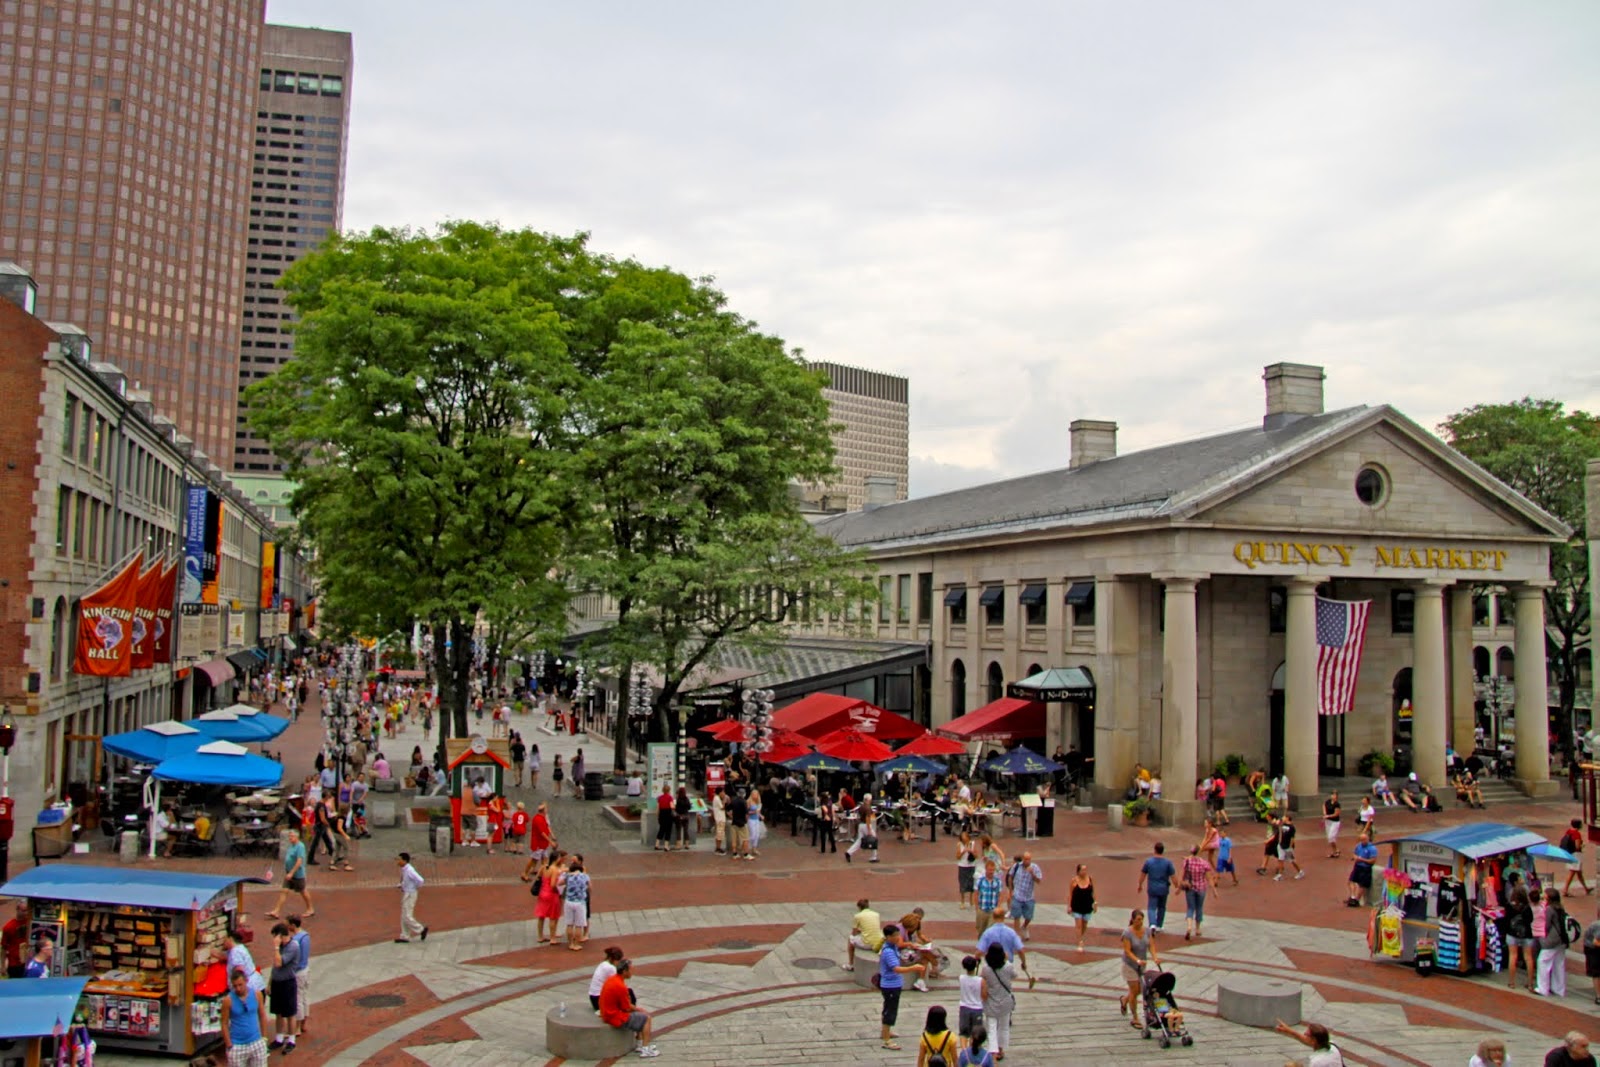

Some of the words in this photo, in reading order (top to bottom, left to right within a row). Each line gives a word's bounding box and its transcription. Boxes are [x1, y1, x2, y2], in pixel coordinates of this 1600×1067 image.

[189, 488, 199, 507] Hall
[197, 489, 206, 542] MARKETPLACE
[188, 509, 198, 542] Faneuil
[1233, 541, 1357, 569] QUINCY
[1375, 544, 1507, 571] MARKET
[82, 606, 132, 622] KINGFISH
[133, 607, 154, 621] FISH
[88, 648, 119, 660] HALL
[131, 645, 144, 655] LL
[517, 814, 524, 825] 9
